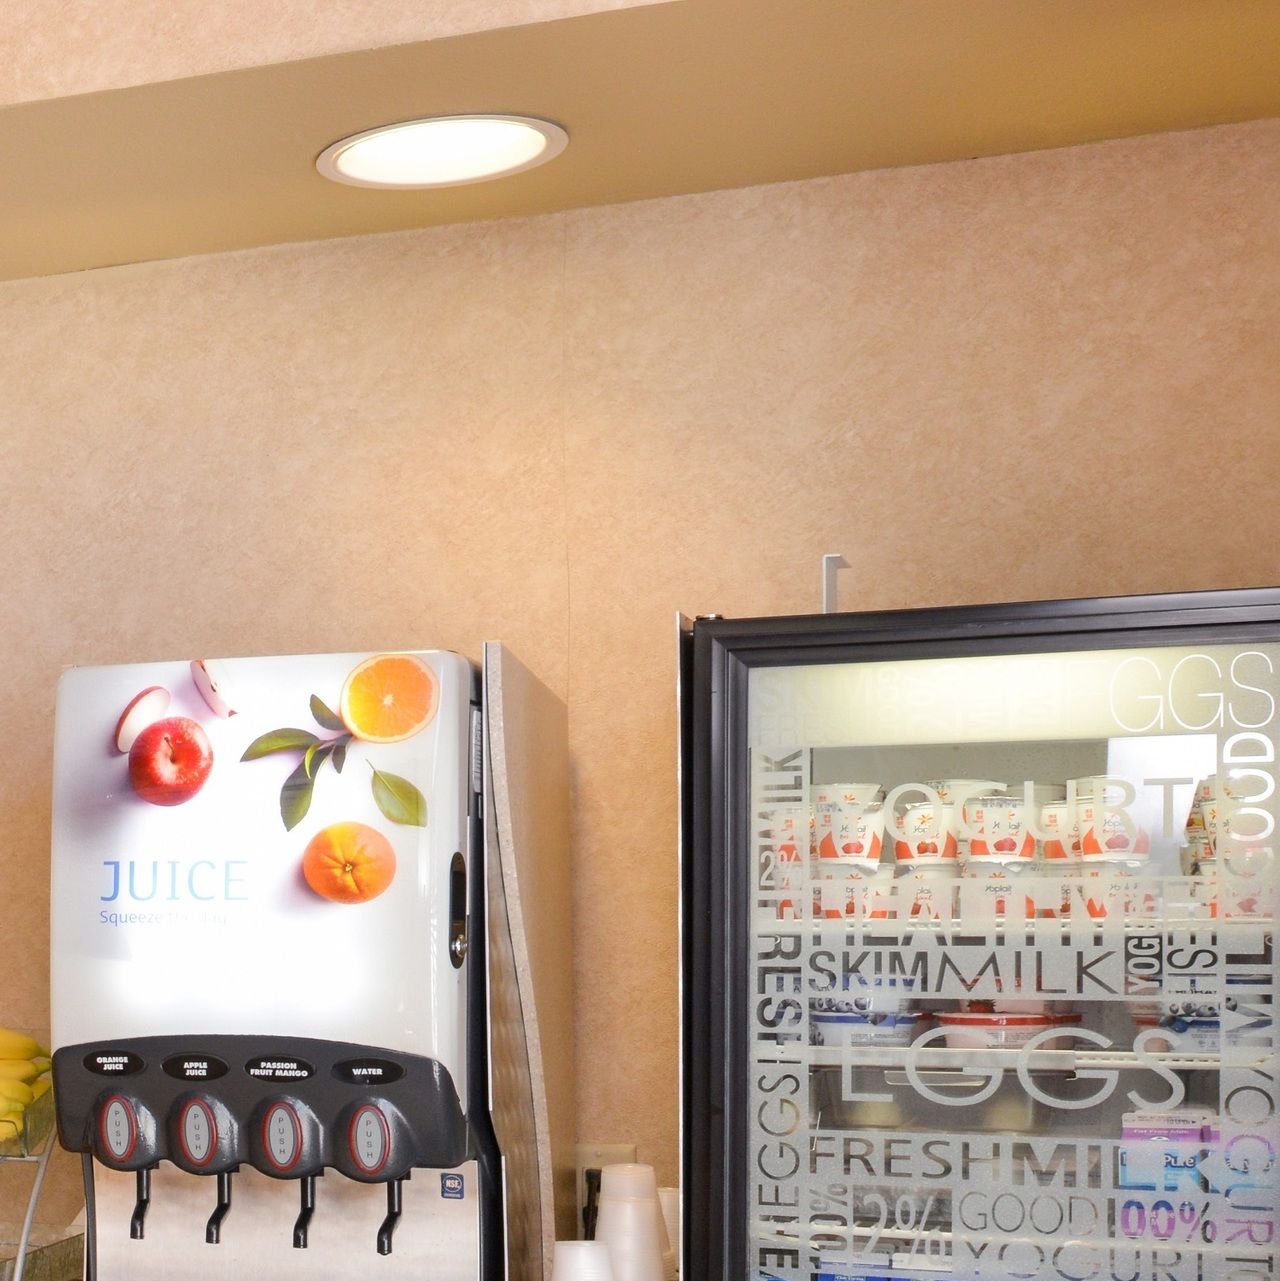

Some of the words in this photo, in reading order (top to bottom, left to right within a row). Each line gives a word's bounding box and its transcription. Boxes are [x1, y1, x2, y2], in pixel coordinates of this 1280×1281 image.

[1108, 651, 1275, 733] GGS
[100, 860, 249, 902] JUICE
[100, 910, 162, 927] Squeeze
[96, 1056, 128, 1064] ORANGE
[103, 1063, 124, 1071] JUICE
[260, 1061, 297, 1070] PASSION
[841, 1025, 1186, 1111] EGGS
[250, 1068, 273, 1076] FRUIT
[275, 1069, 309, 1077] MANGO
[352, 1068, 383, 1076] WATER
[193, 1113, 202, 1151] PUSH
[278, 1117, 286, 1155] PUSH
[757, 1072, 801, 1207] EGGS
[445, 1178, 459, 1189] NSF
